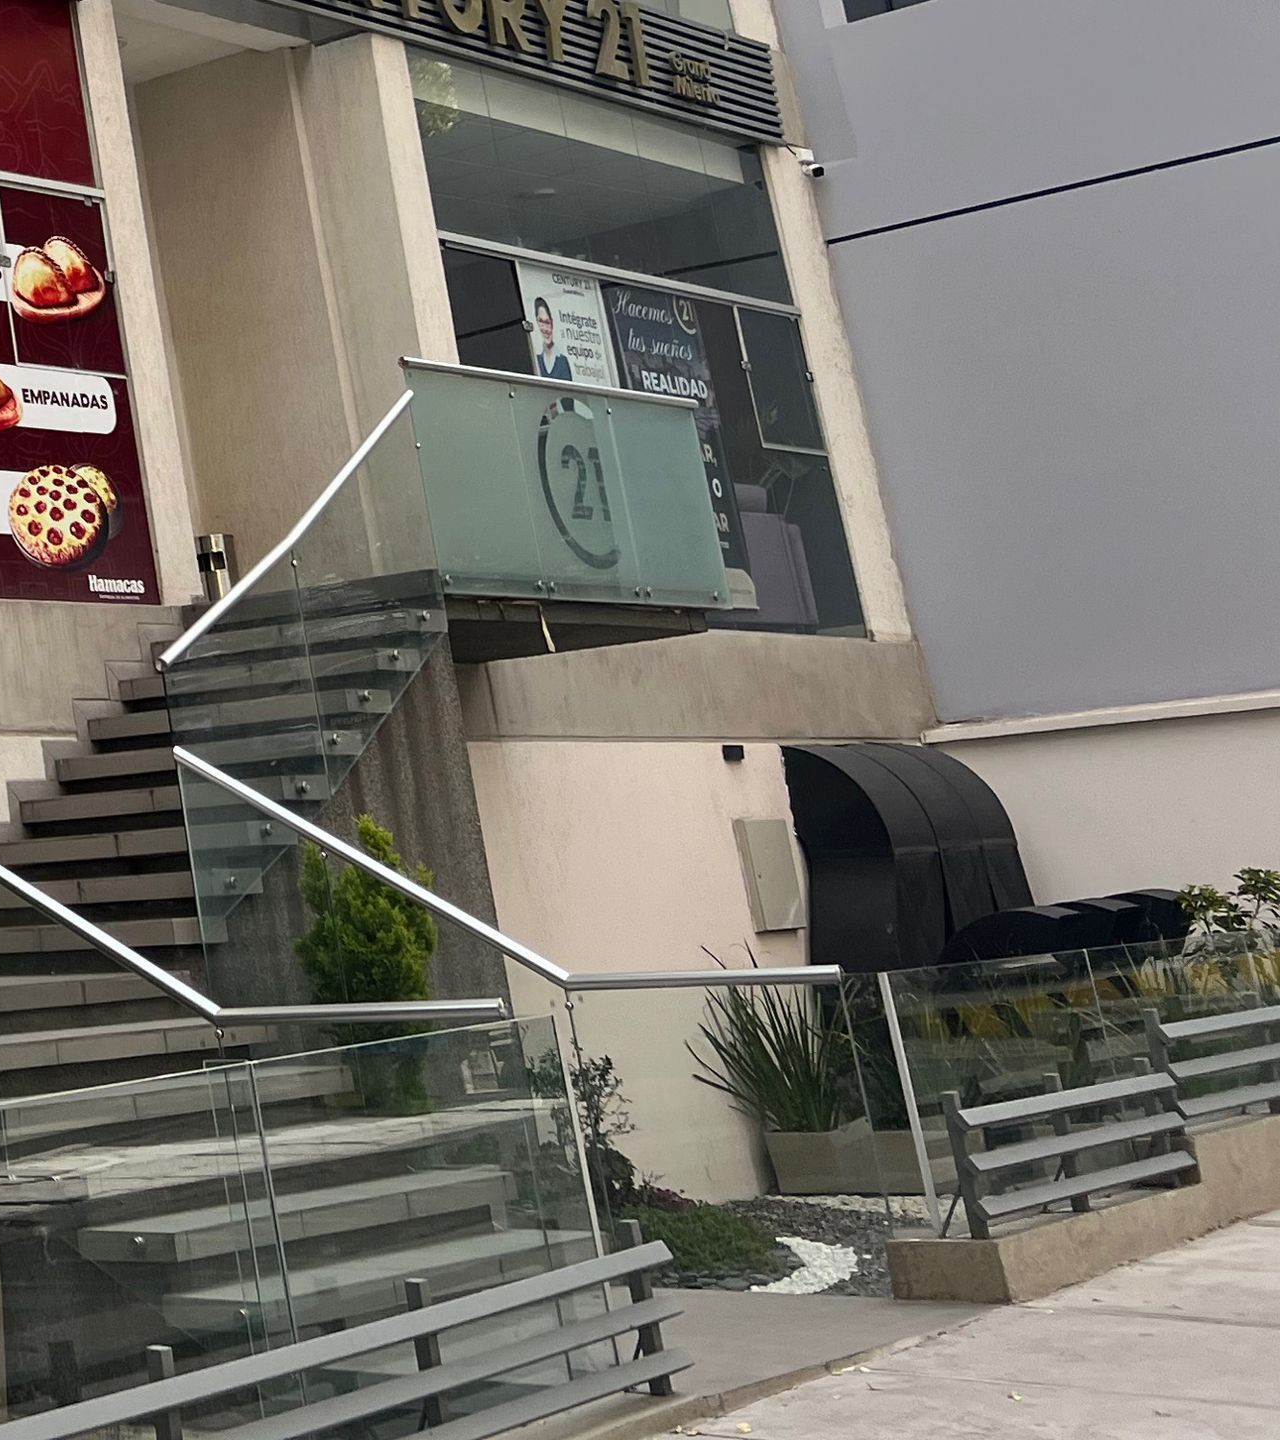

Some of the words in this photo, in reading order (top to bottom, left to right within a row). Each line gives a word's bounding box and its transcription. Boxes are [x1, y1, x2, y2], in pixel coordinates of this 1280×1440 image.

[669, 50, 712, 79] Grand
[612, 288, 674, 325] Hacemos
[628, 327, 645, 353] tus
[650, 338, 693, 361] sueños
[21, 387, 109, 410] EMPANADAS
[641, 370, 708, 399] REALIDAD
[560, 444, 612, 522] 21
[88, 574, 145, 594] Hamacas
